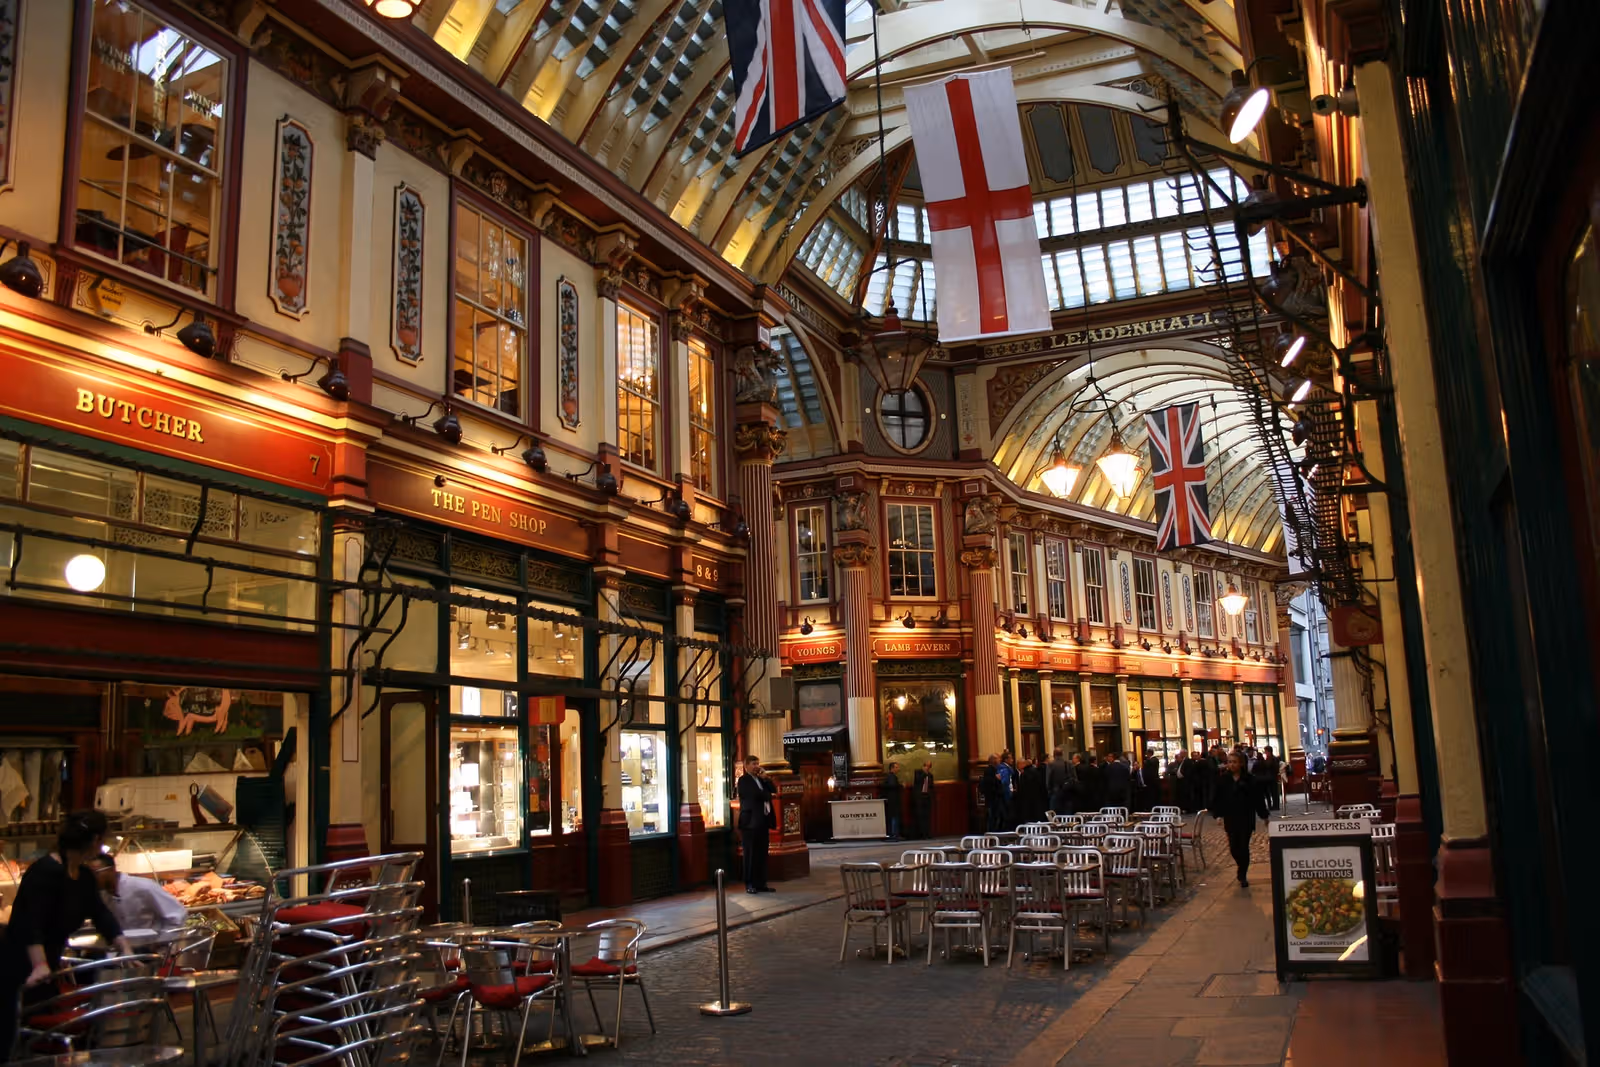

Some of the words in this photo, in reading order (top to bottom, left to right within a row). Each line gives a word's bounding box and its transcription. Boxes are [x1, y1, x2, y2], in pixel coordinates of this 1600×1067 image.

[188, 88, 218, 114] WINE
[192, 102, 213, 121] BAR
[75, 387, 204, 443] BUTCHER
[310, 454, 320, 475] 7
[431, 488, 465, 514] THE
[471, 500, 502, 524] PEN
[509, 511, 547, 535] SHOP
[696, 564, 702, 577] 8
[704, 567, 711, 580] &
[713, 569, 718, 581] 9
[797, 645, 836, 657] YOUNGS
[884, 643, 911, 652] LAMB
[914, 643, 951, 652] TAVERN
[782, 737, 796, 745] OLD
[1278, 823, 1310, 832] PIZZA
[1311, 822, 1361, 831] EXPRESS
[1290, 859, 1353, 869] DELICIOUS
[1292, 870, 1300, 879] &
[1301, 870, 1352, 879] NUTRITIOUS
